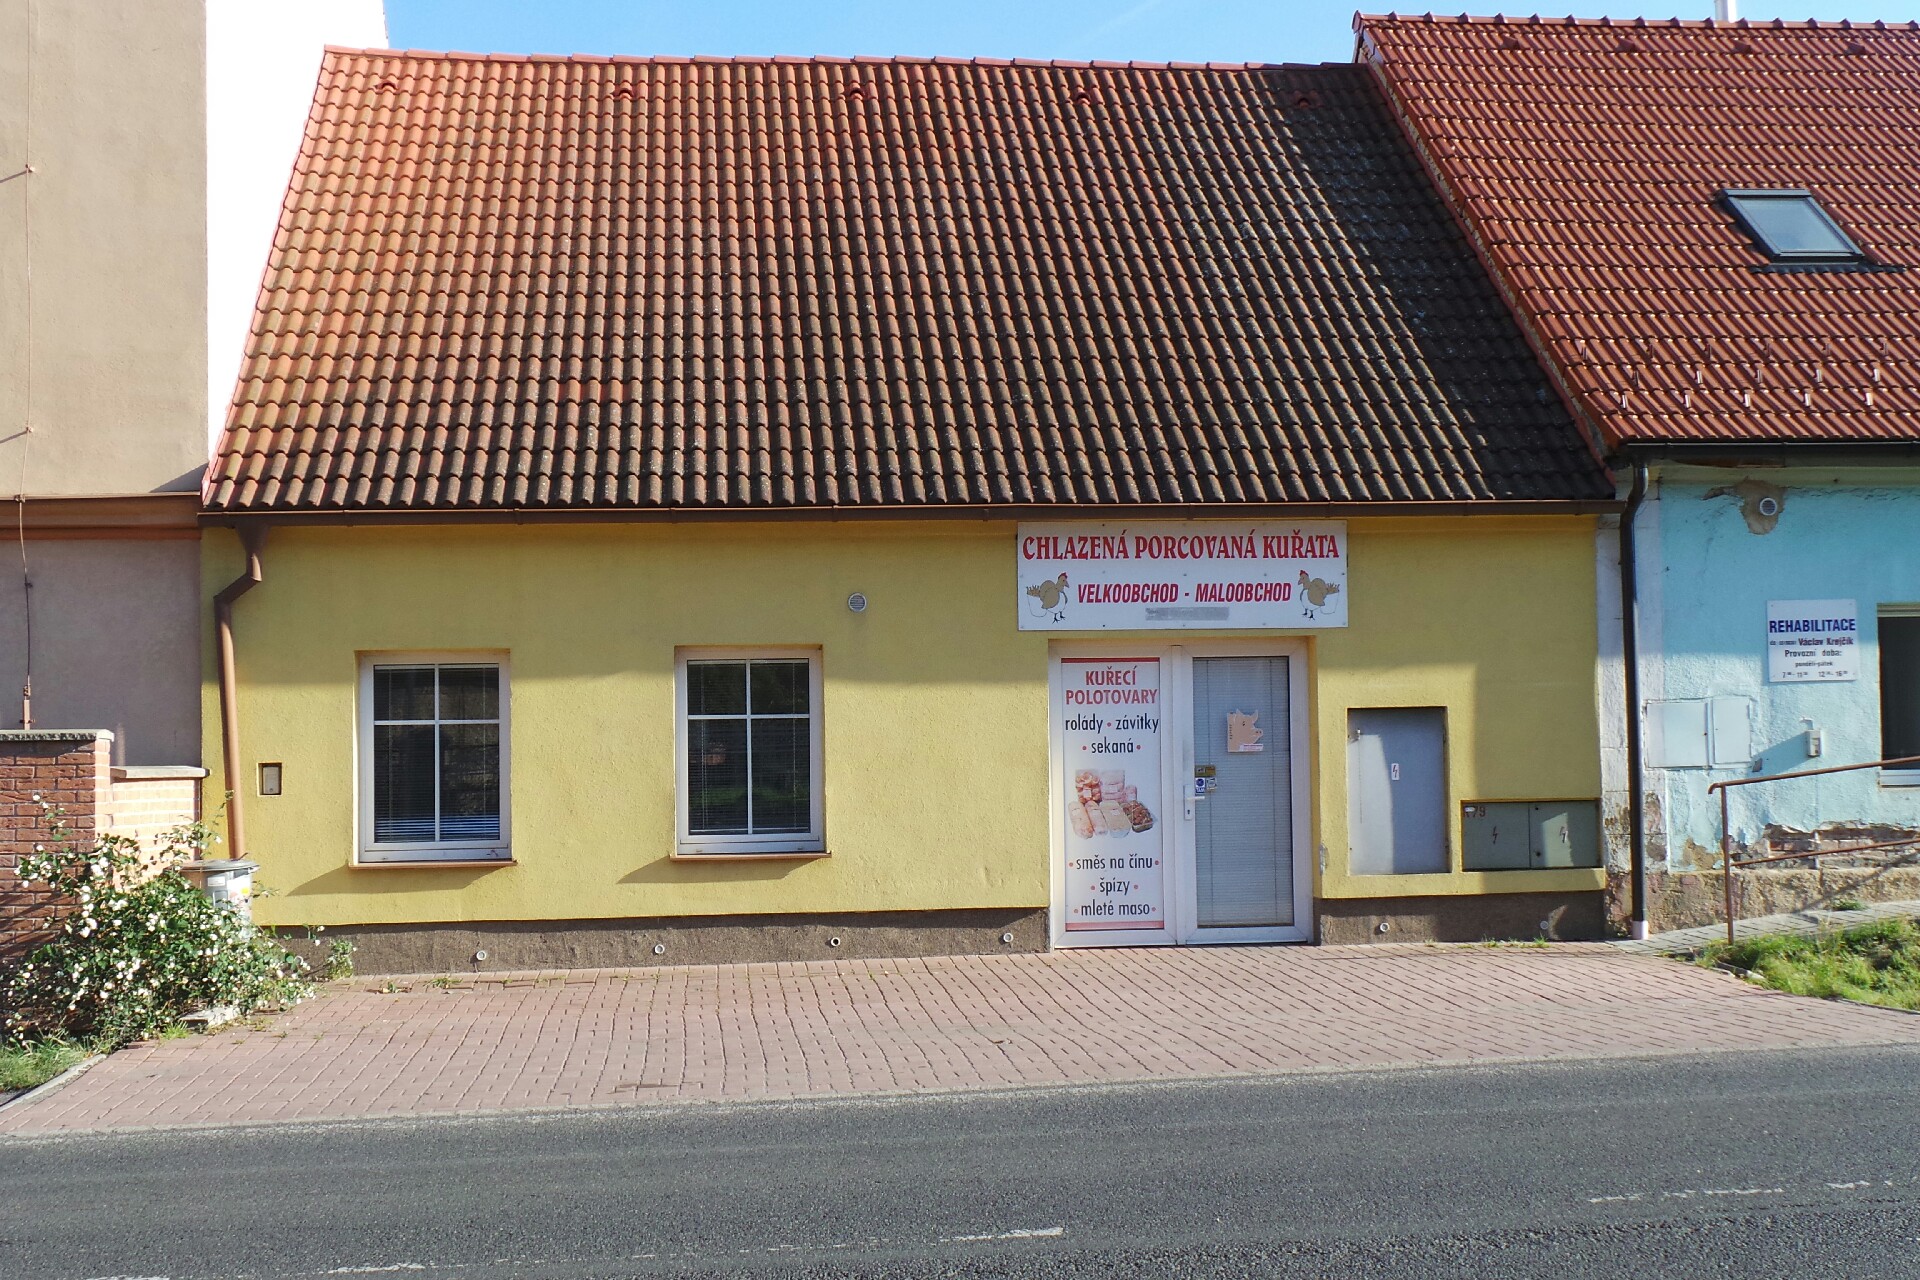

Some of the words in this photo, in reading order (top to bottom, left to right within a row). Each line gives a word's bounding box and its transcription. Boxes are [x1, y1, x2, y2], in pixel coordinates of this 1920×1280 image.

[1022, 529, 1128, 561] CHLAZENÁ
[1134, 528, 1258, 560] PORCOVANÁ
[1262, 528, 1340, 560] KUŘATA
[1077, 582, 1179, 604] VELKOOBCHOD
[1194, 581, 1292, 603] MALOOBCHOD
[1769, 619, 1856, 633] REHABILITACE
[1822, 649, 1843, 657] doba:
[1085, 665, 1137, 686] KUŘECÍ
[1065, 689, 1158, 705] POLOTOVARY
[1065, 713, 1104, 735] rolády
[1115, 713, 1159, 734] závitky
[1091, 737, 1134, 754] sekaná
[1076, 854, 1106, 870] směs
[1109, 857, 1125, 869] na
[1128, 853, 1153, 870] čínu
[1099, 876, 1130, 896] špízy
[1080, 899, 1114, 916] mleté
[1118, 903, 1150, 916] maso
